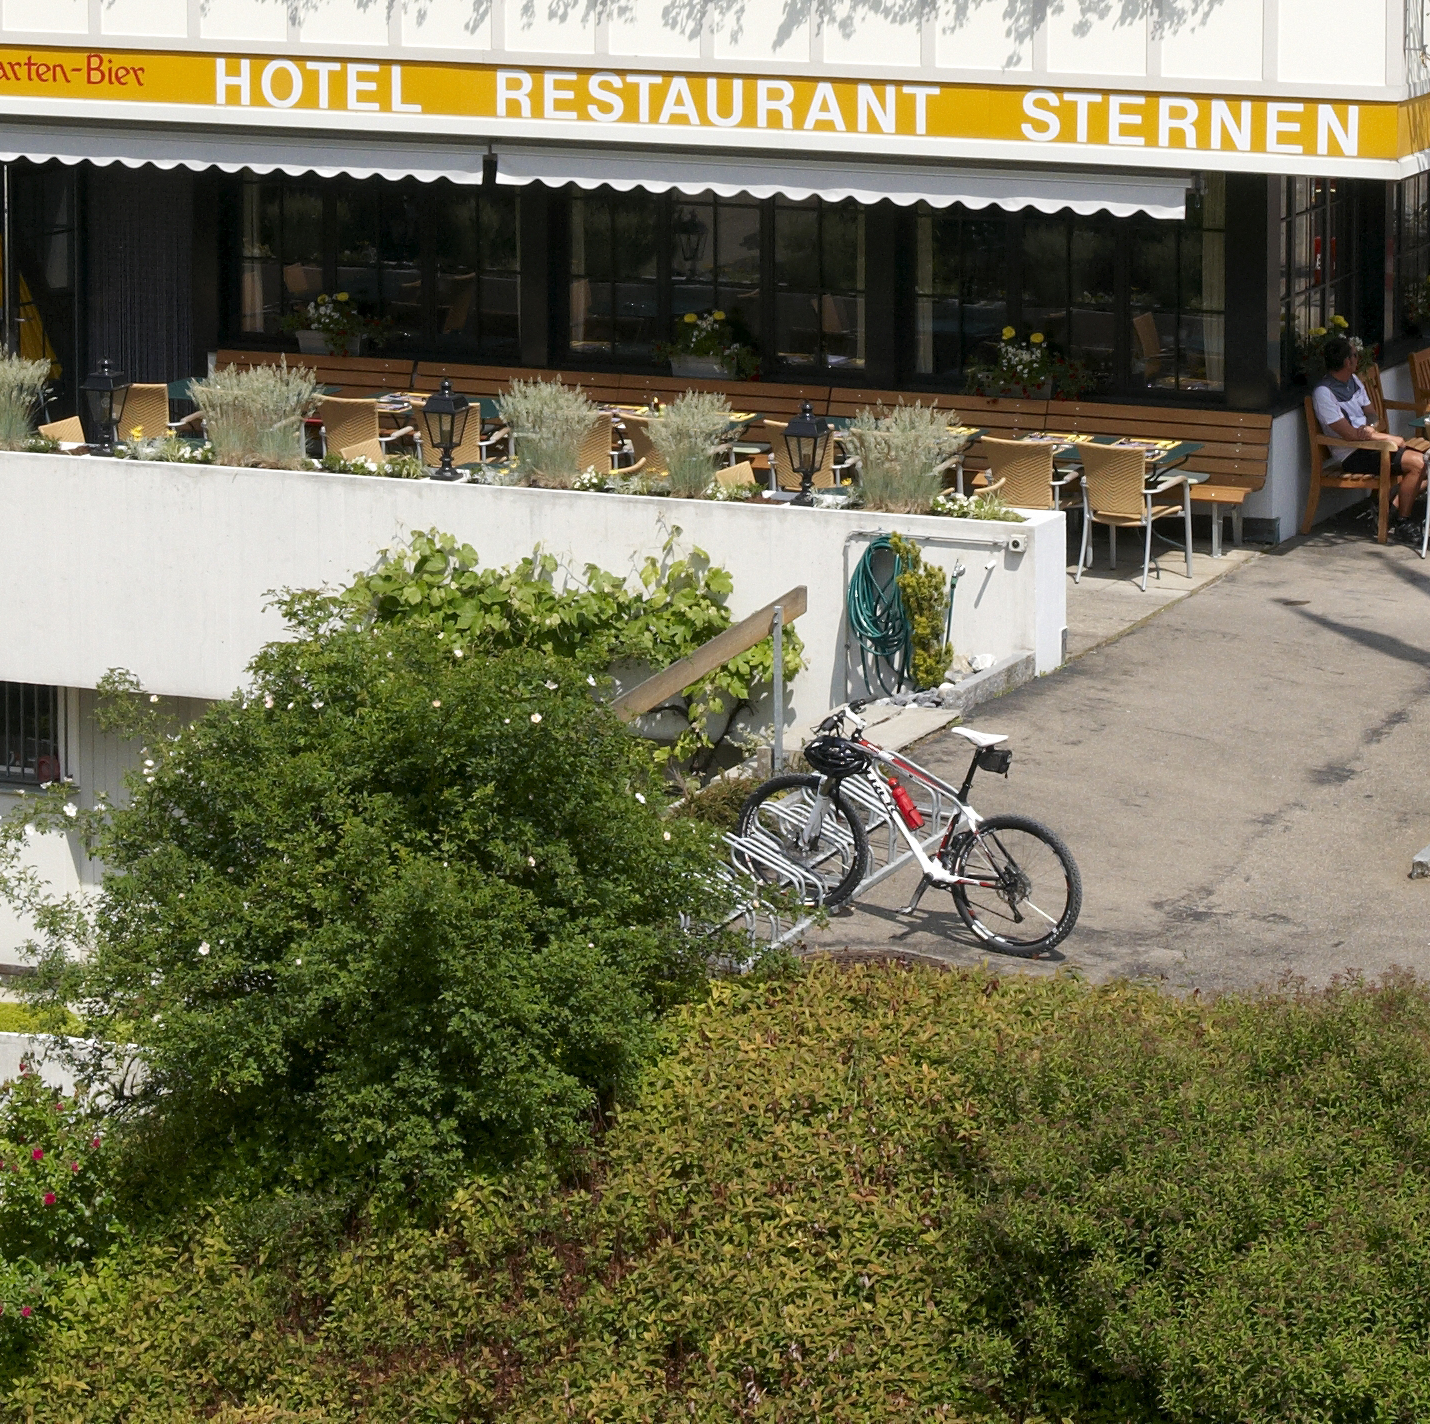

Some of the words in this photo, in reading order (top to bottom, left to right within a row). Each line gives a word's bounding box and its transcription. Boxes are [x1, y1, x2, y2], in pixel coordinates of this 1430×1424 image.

[215, 57, 423, 114] HOTEL
[496, 69, 941, 137] RESTAURANT
[1020, 89, 1361, 158] STERNEN
